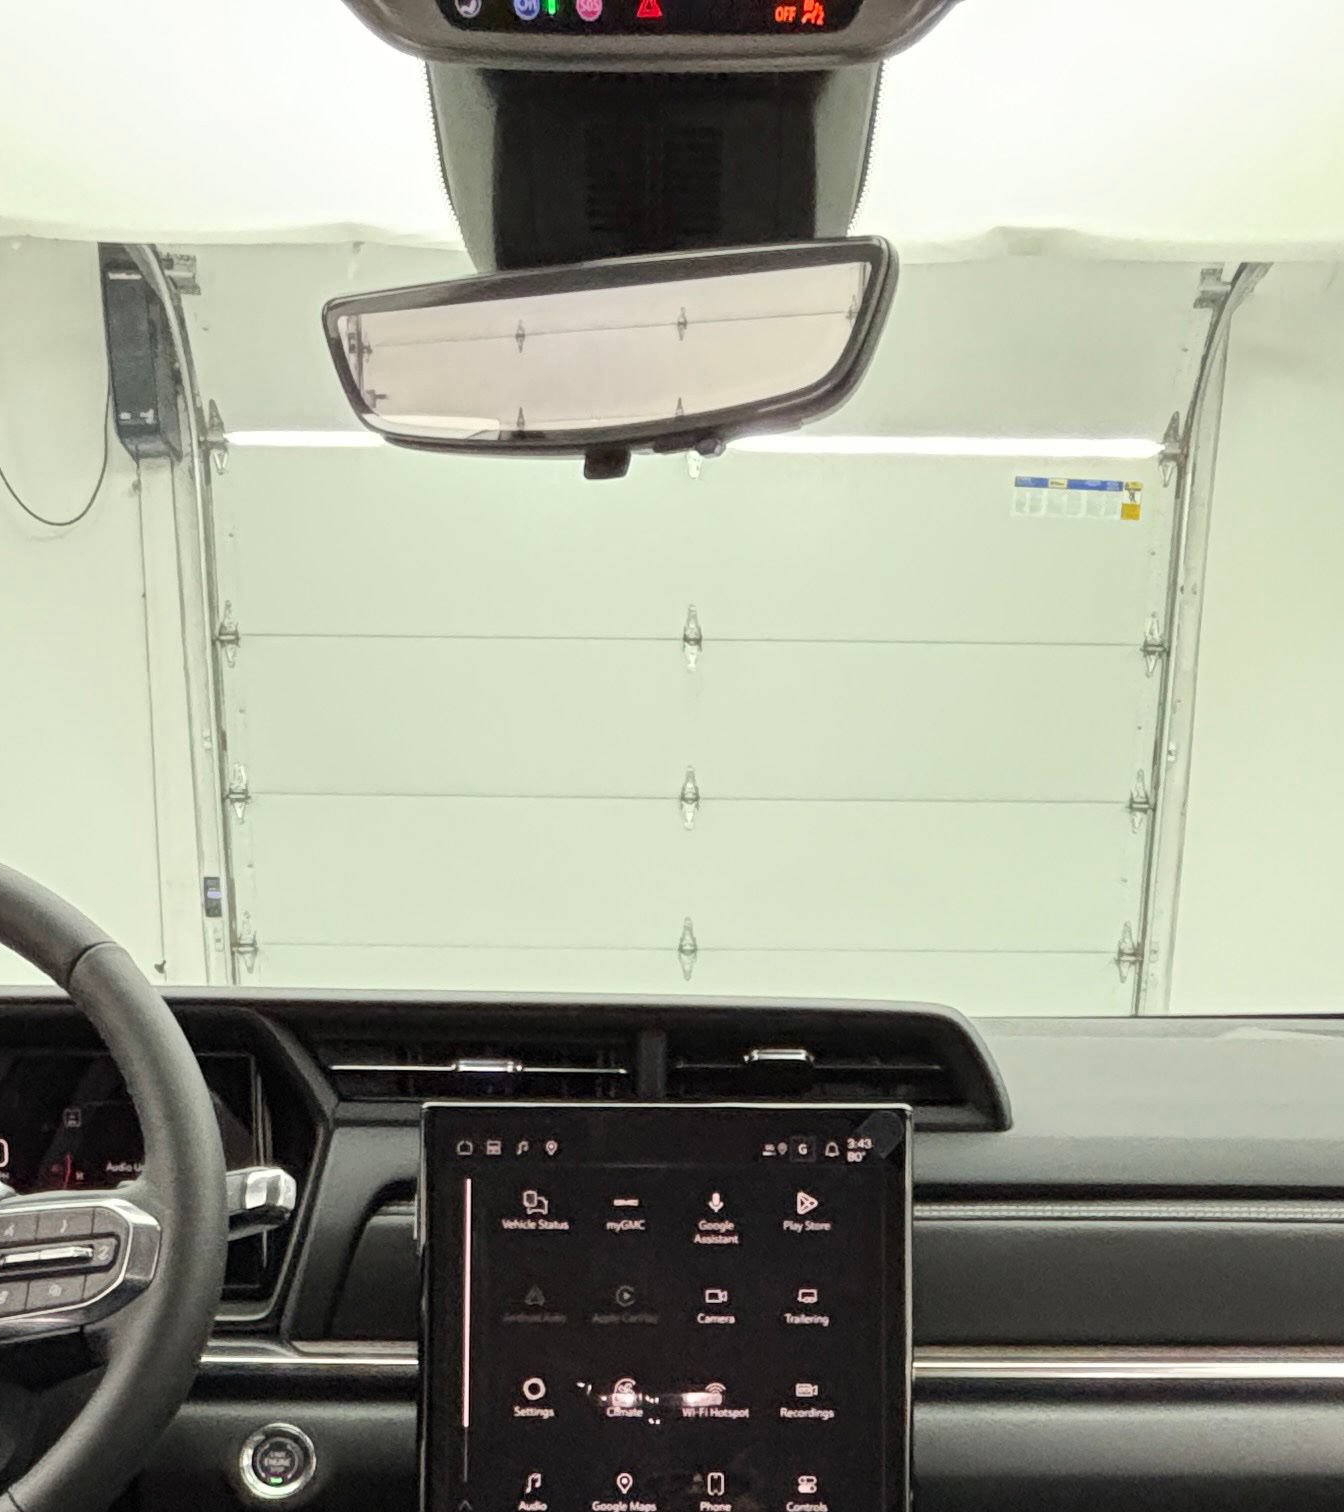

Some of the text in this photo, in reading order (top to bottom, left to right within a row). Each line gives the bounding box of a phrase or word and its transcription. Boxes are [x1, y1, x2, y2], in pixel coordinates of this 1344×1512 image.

[775, 6, 797, 23] OFF
[847, 1138, 872, 1150] 3:43
[501, 1218, 570, 1230] Vehicle Status
[606, 1219, 646, 1233] myGMC
[698, 1219, 734, 1234] Google
[783, 1219, 832, 1233] Play Store
[693, 1233, 739, 1245] Assistant
[696, 1312, 736, 1324] Camera
[783, 1312, 830, 1327] Trailering
[513, 1405, 555, 1420] Settings
[606, 1406, 644, 1418] Climate
[681, 1406, 750, 1420] Wi-Fi Hotspot
[779, 1406, 835, 1421] Recordings
[517, 1500, 548, 1512] Audio
[699, 1500, 733, 1512] Phone
[785, 1501, 829, 1512] Controls
